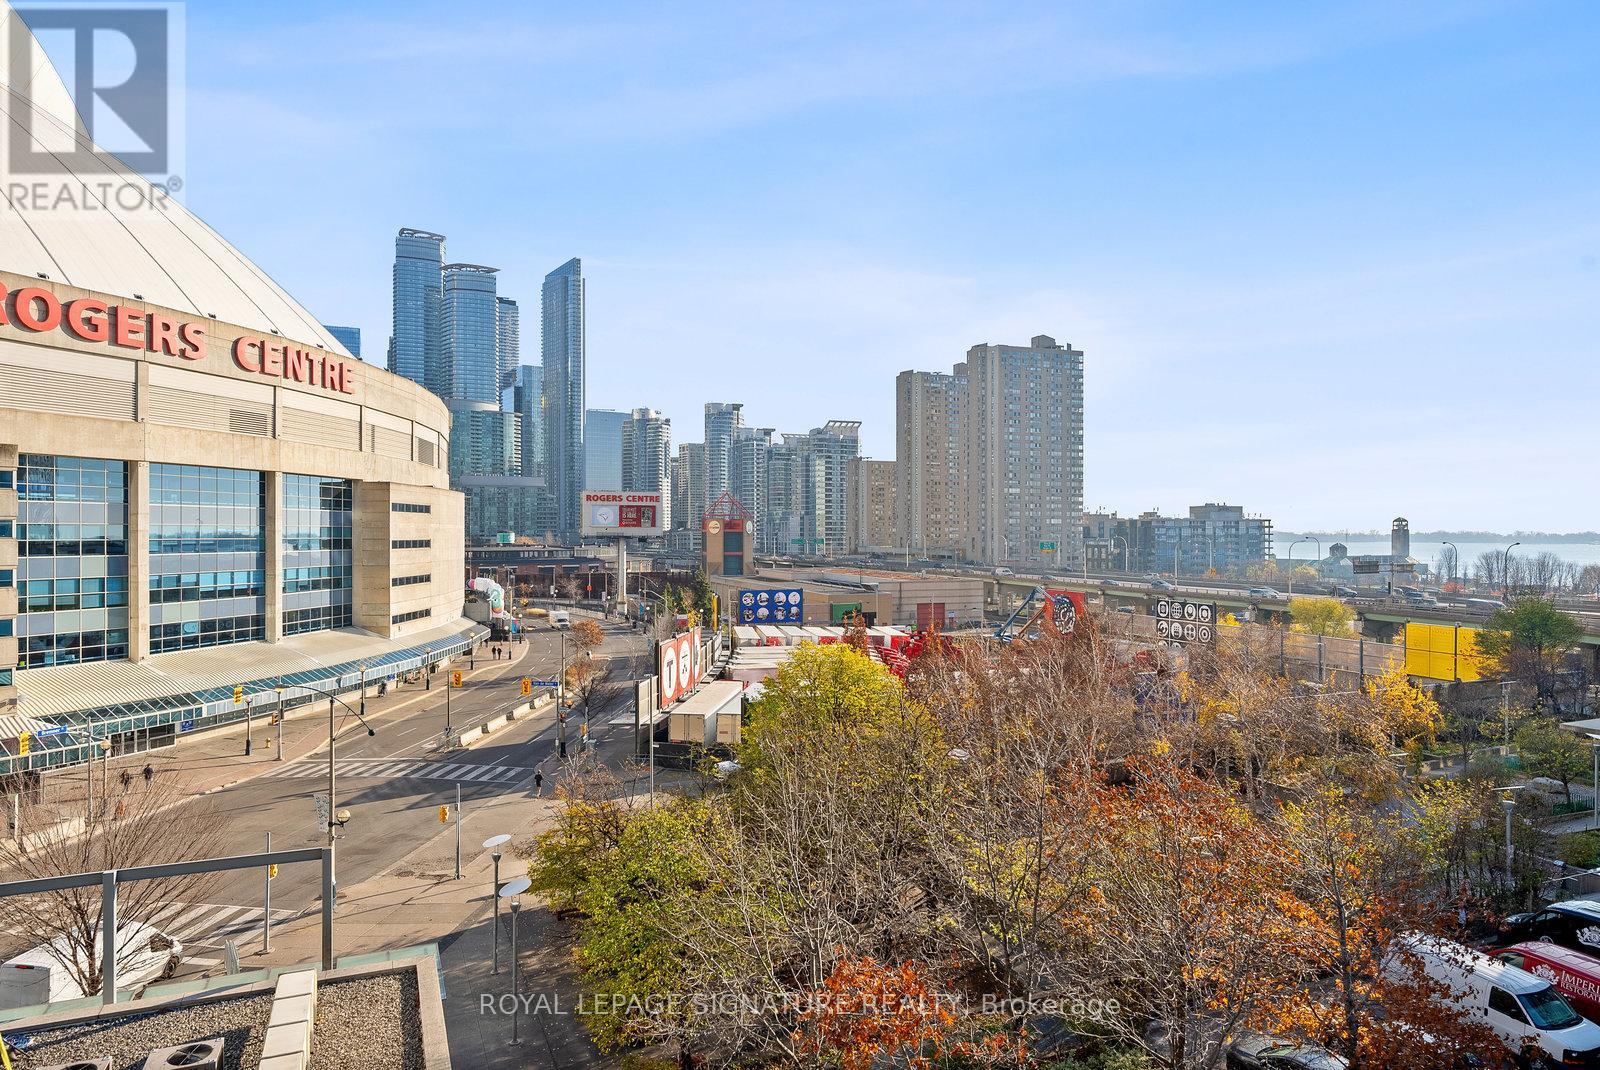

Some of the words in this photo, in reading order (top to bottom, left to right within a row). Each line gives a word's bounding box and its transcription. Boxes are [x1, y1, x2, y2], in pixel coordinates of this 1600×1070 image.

[232, 335, 356, 395] CENTRE
[586, 494, 623, 502] ROGERS
[1561, 970, 1600, 994] IMPERI
